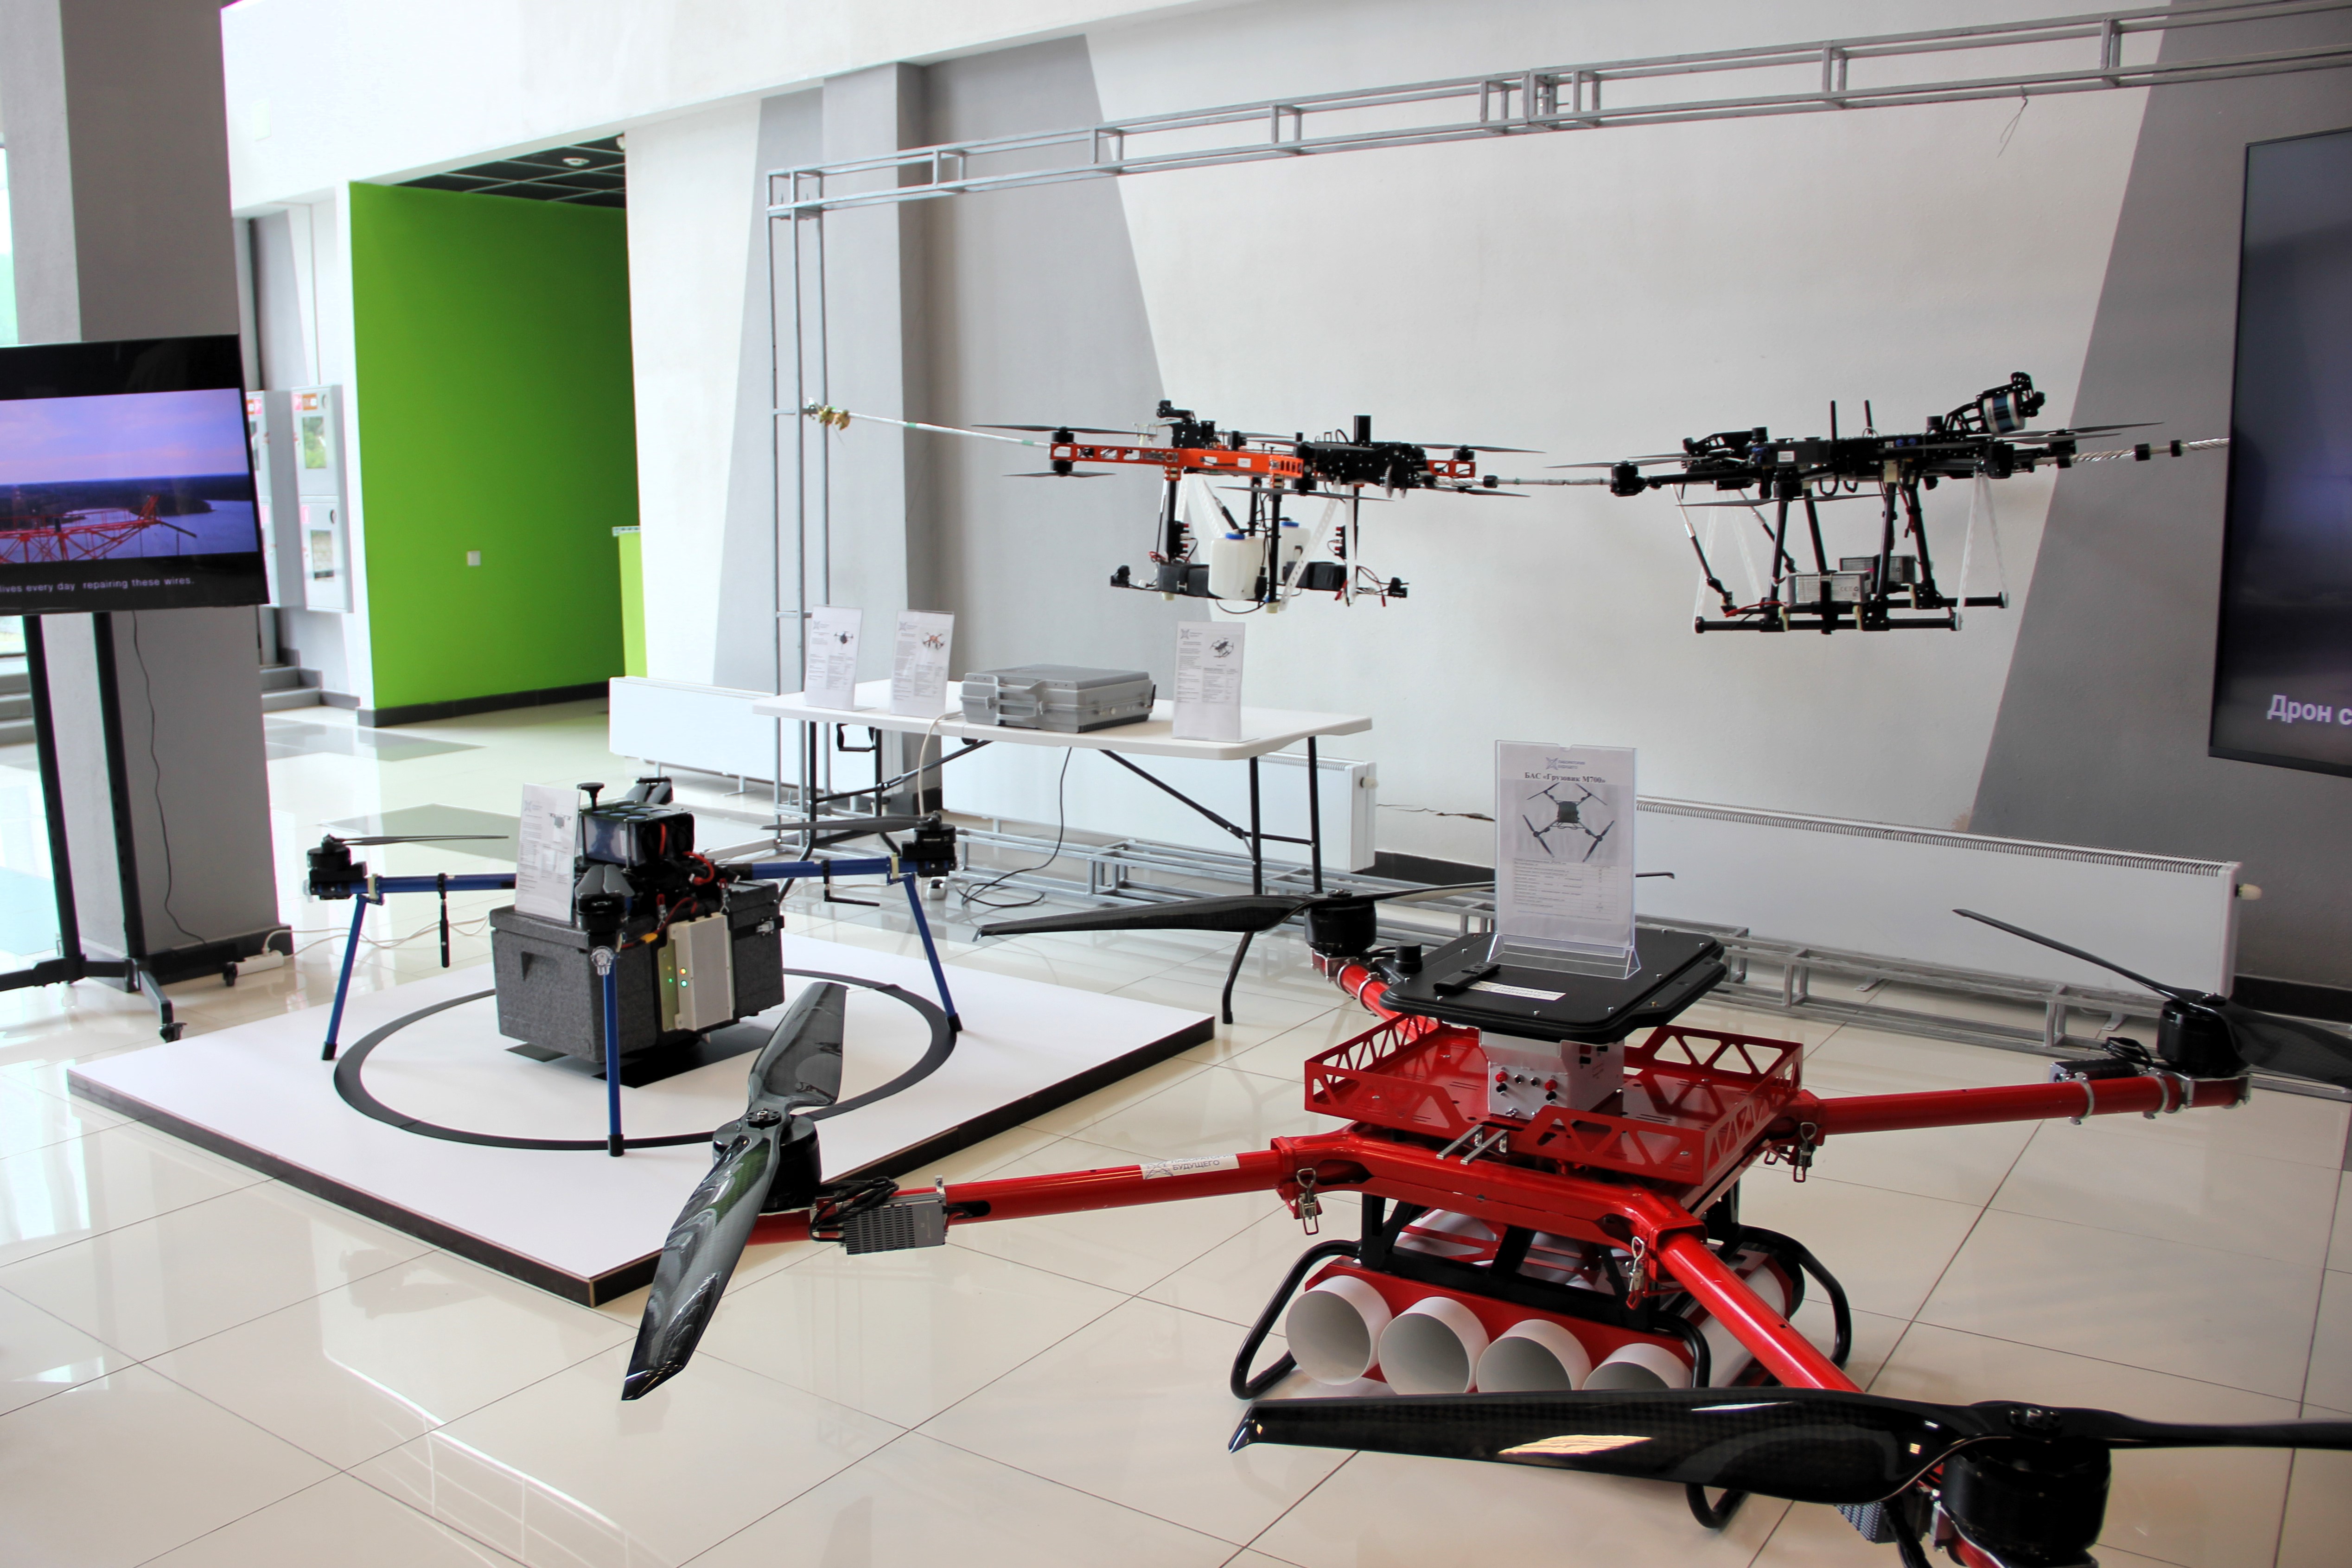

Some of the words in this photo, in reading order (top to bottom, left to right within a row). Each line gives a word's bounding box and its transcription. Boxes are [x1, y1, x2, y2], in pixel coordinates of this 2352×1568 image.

[57, 582, 75, 591] day
[82, 580, 128, 590] repairing
[164, 576, 194, 585] wires.
[2267, 695, 2332, 723] Дрон
[1173, 1160, 1220, 1170] БУДУЩЕГО
